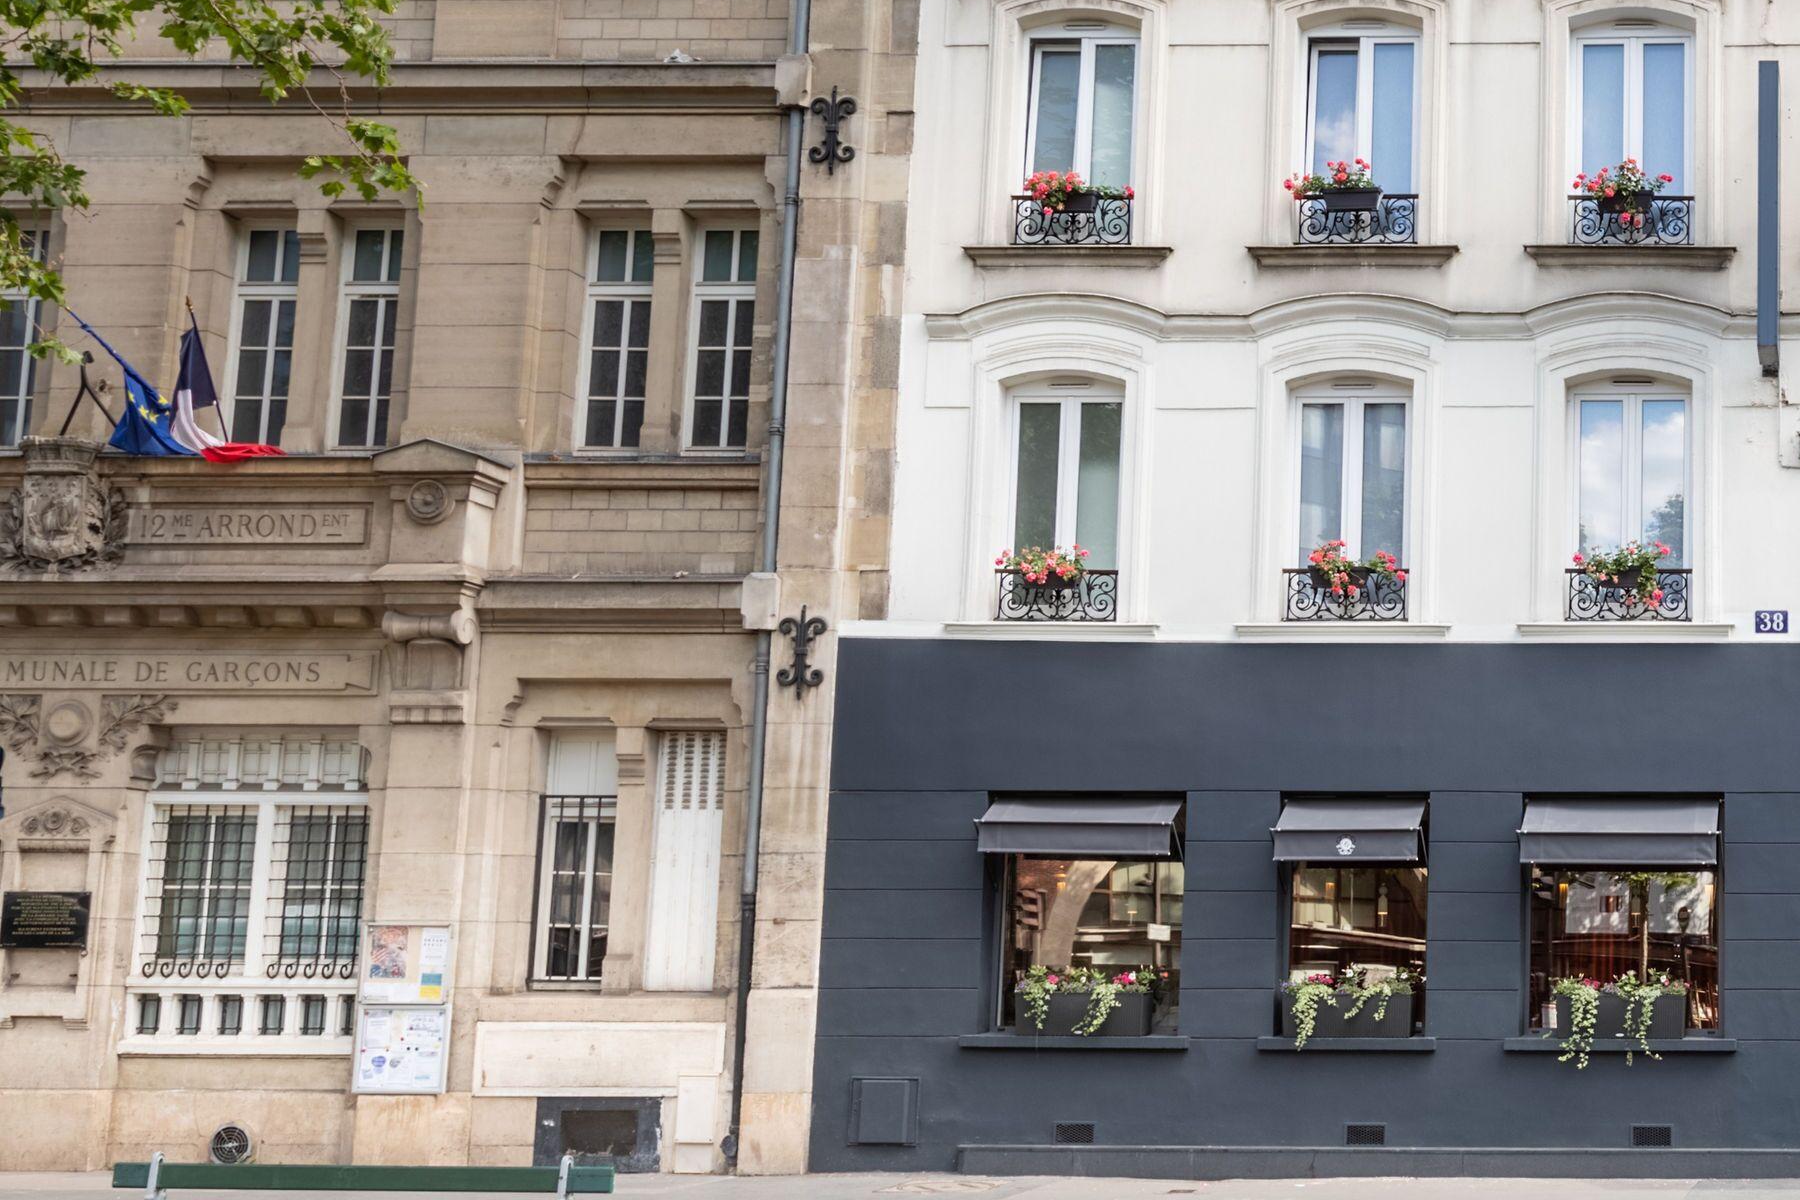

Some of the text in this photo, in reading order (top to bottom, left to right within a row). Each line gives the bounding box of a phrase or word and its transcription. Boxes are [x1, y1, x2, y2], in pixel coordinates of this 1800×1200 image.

[1760, 612, 1784, 631] 38
[5, 660, 321, 687] MUNALE DE GARÇONS
